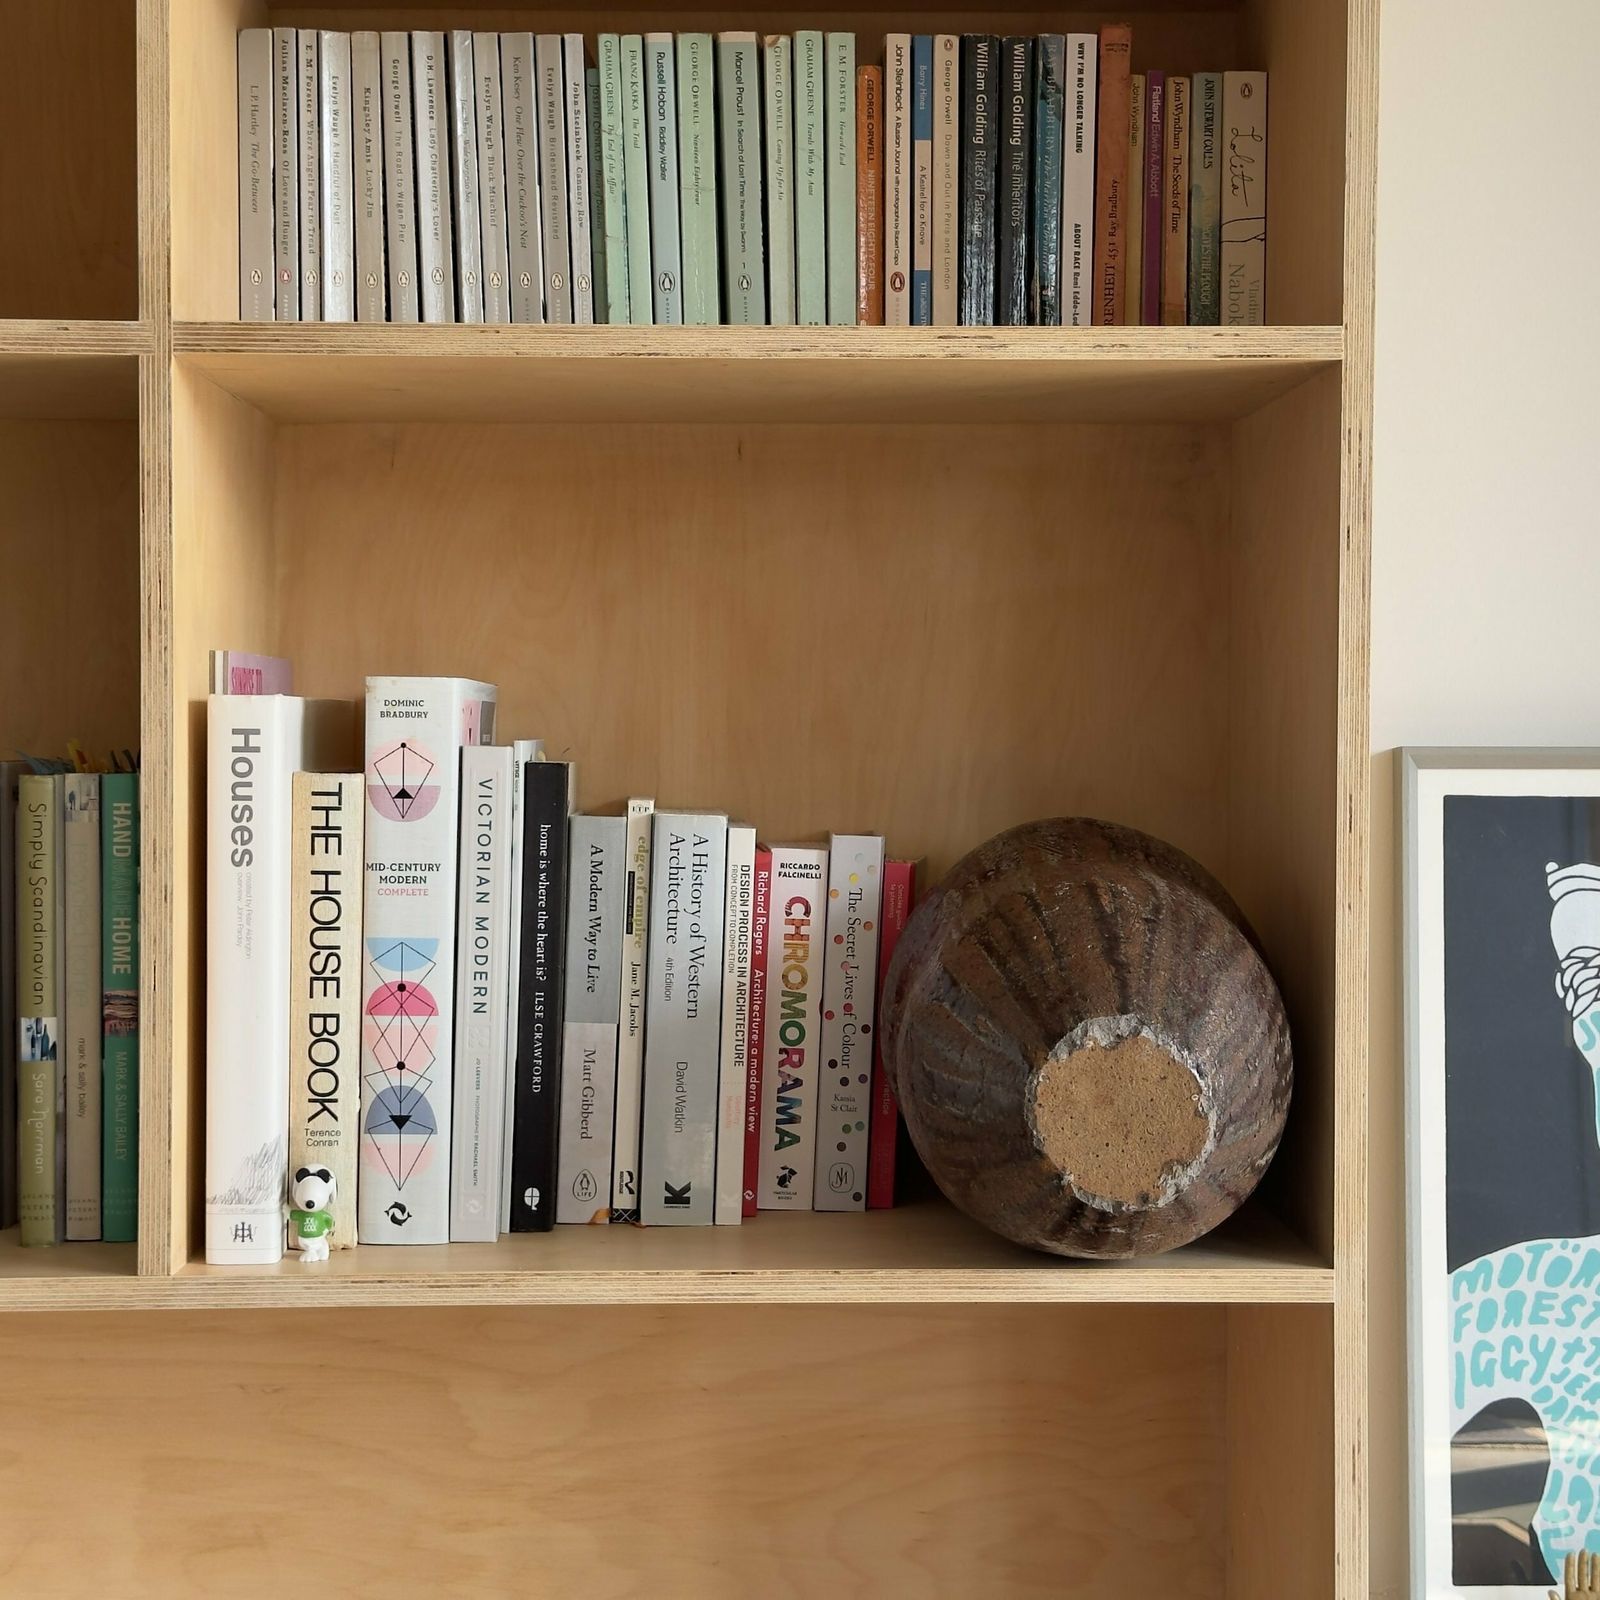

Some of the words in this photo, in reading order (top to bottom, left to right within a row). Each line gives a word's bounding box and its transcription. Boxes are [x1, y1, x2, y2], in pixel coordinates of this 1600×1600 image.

[629, 49, 638, 80] FRANZ
[657, 51, 667, 84] Russell
[690, 42, 700, 82] GEORGE
[735, 51, 745, 84] Marcel
[773, 46, 783, 87] GEORGE
[805, 39, 815, 79] GRAHAM
[895, 44, 905, 66] John
[976, 42, 989, 91] William
[1012, 42, 1025, 92] William
[1076, 42, 1086, 60] WHY
[918, 64, 928, 87] Barry
[943, 59, 952, 93] George
[1076, 62, 1086, 75] I'M
[1076, 77, 1085, 89] NO
[484, 76, 493, 111] Evelyn
[572, 81, 581, 106] John
[630, 81, 640, 111] KAFKA
[658, 86, 668, 121] Hoban
[692, 84, 701, 126] ORWELL
[736, 86, 746, 117] Proust
[805, 80, 815, 117] GREENE
[838, 69, 847, 113] FORSTER
[866, 79, 875, 121] GEORGE
[895, 67, 905, 112] Steinbeck
[919, 88, 927, 110] Hines
[1075, 90, 1085, 120] LONGER
[1131, 83, 1140, 104] John
[1151, 85, 1162, 123] Flatland
[1172, 80, 1183, 102] John
[1204, 78, 1214, 101] JOHN
[363, 88, 373, 134] Kingsley
[774, 89, 784, 131] ORWELL
[945, 95, 953, 125] Orwell
[972, 93, 988, 145] Golding
[1009, 94, 1025, 146] Golding
[1131, 105, 1141, 147] Wyndham
[1171, 102, 1183, 150] Wyndham
[1203, 102, 1214, 139] STEWART
[484, 114, 494, 151] Waugh
[574, 109, 583, 161] Steinbeck
[658, 126, 667, 155] Riddley
[866, 122, 875, 164] ORWELL
[1075, 121, 1085, 154] TALKING
[1151, 123, 1161, 153] Edwin
[365, 137, 373, 163] Amis
[975, 149, 987, 177] Rites
[1012, 150, 1024, 171] The
[1172, 155, 1182, 173] The
[1203, 140, 1214, 169] COLLIS
[364, 169, 374, 199] Lucky
[660, 155, 669, 181] Walker
[1150, 163, 1160, 198] Abbott
[1229, 127, 1264, 208] Lolita
[975, 179, 987, 191] of
[1011, 173, 1024, 228] Inheritors
[1109, 179, 1121, 219] Bradbury
[1172, 174, 1182, 200] Seeds
[366, 202, 374, 218] Jim
[972, 193, 985, 238] Passage
[1172, 200, 1183, 211] of
[1073, 222, 1082, 248] ABOUT
[1172, 211, 1183, 234] Time
[1073, 250, 1082, 270] RACE
[379, 710, 429, 720] BRADBURY
[383, 699, 425, 708] DOMINIC
[230, 727, 262, 869] Houses
[27, 801, 49, 870] Simply
[310, 781, 343, 857] THE
[475, 777, 493, 905] VICTORIAN
[539, 823, 552, 857] home
[591, 844, 604, 856] A
[632, 836, 649, 873] edge
[692, 832, 709, 847] A
[366, 863, 442, 873] MID-CENTURY
[378, 875, 428, 885] MODERN
[539, 860, 551, 870] is
[731, 863, 739, 885] FROM
[778, 870, 822, 881] FALCINELLI
[779, 862, 821, 871] RICCARDO
[376, 887, 430, 897] COMPLETE
[537, 872, 551, 908] where
[589, 859, 604, 912] Modern
[635, 875, 648, 893] of
[665, 831, 688, 945] Architecture
[684, 851, 709, 917] History
[738, 863, 752, 908] DESIGN
[754, 870, 769, 914] Richard
[729, 885, 738, 918] CONCEPT
[847, 888, 863, 914] The
[309, 869, 343, 999] HOUSE
[537, 910, 550, 930] the
[584, 915, 602, 944] Way
[631, 895, 647, 949] empire
[688, 922, 707, 943] of
[729, 918, 737, 929] TO
[735, 909, 751, 964] PROCESS
[752, 916, 768, 957] Rogers
[29, 876, 50, 1006] Scandinavian
[537, 932, 550, 963] heart
[588, 947, 599, 961] to
[728, 929, 737, 974] COMPLETION
[846, 916, 862, 962] Secret
[472, 916, 490, 1015] MODERN
[536, 966, 548, 981] is?
[586, 963, 601, 994] Live
[630, 960, 642, 986] Jane
[664, 956, 676, 972] 4th
[735, 966, 747, 979] IN
[629, 987, 641, 1001] M.
[663, 972, 675, 1002] Edition
[685, 945, 706, 1020] Western
[843, 963, 860, 1001] Lives
[534, 991, 546, 1019] ILSE
[628, 1002, 640, 1038] Jacobs
[750, 968, 766, 1044] Architecture:
[733, 980, 749, 1068] ARCHITECTURE
[774, 895, 813, 1152] CHROMORAMA
[77, 1037, 88, 1062] mark
[532, 1023, 545, 1093] CRAWFORD
[748, 1047, 759, 1056] a
[840, 1022, 857, 1069] Colour
[77, 1062, 88, 1072] &
[114, 1050, 128, 1080] MARK
[306, 1012, 340, 1124] BOOK
[583, 1048, 597, 1082] Matt
[673, 1060, 689, 1094] David
[747, 1057, 761, 1104] modern
[33, 1072, 49, 1105] Sara
[75, 1073, 89, 1092] sally
[114, 1082, 127, 1092] &
[74, 1092, 88, 1119] bailey
[113, 1093, 127, 1127] SALLY
[580, 1085, 596, 1140] Gibberd
[673, 1094, 688, 1134] Watkin
[746, 1106, 758, 1133] view
[839, 1104, 858, 1113] Clair
[27, 1109, 51, 1175] Norrman
[113, 1127, 127, 1161] BAILEY
[304, 1128, 342, 1137] Terence
[305, 1138, 340, 1148] Conran
[576, 1191, 593, 1199] LIFE
[1454, 1333, 1557, 1411] IGGY
